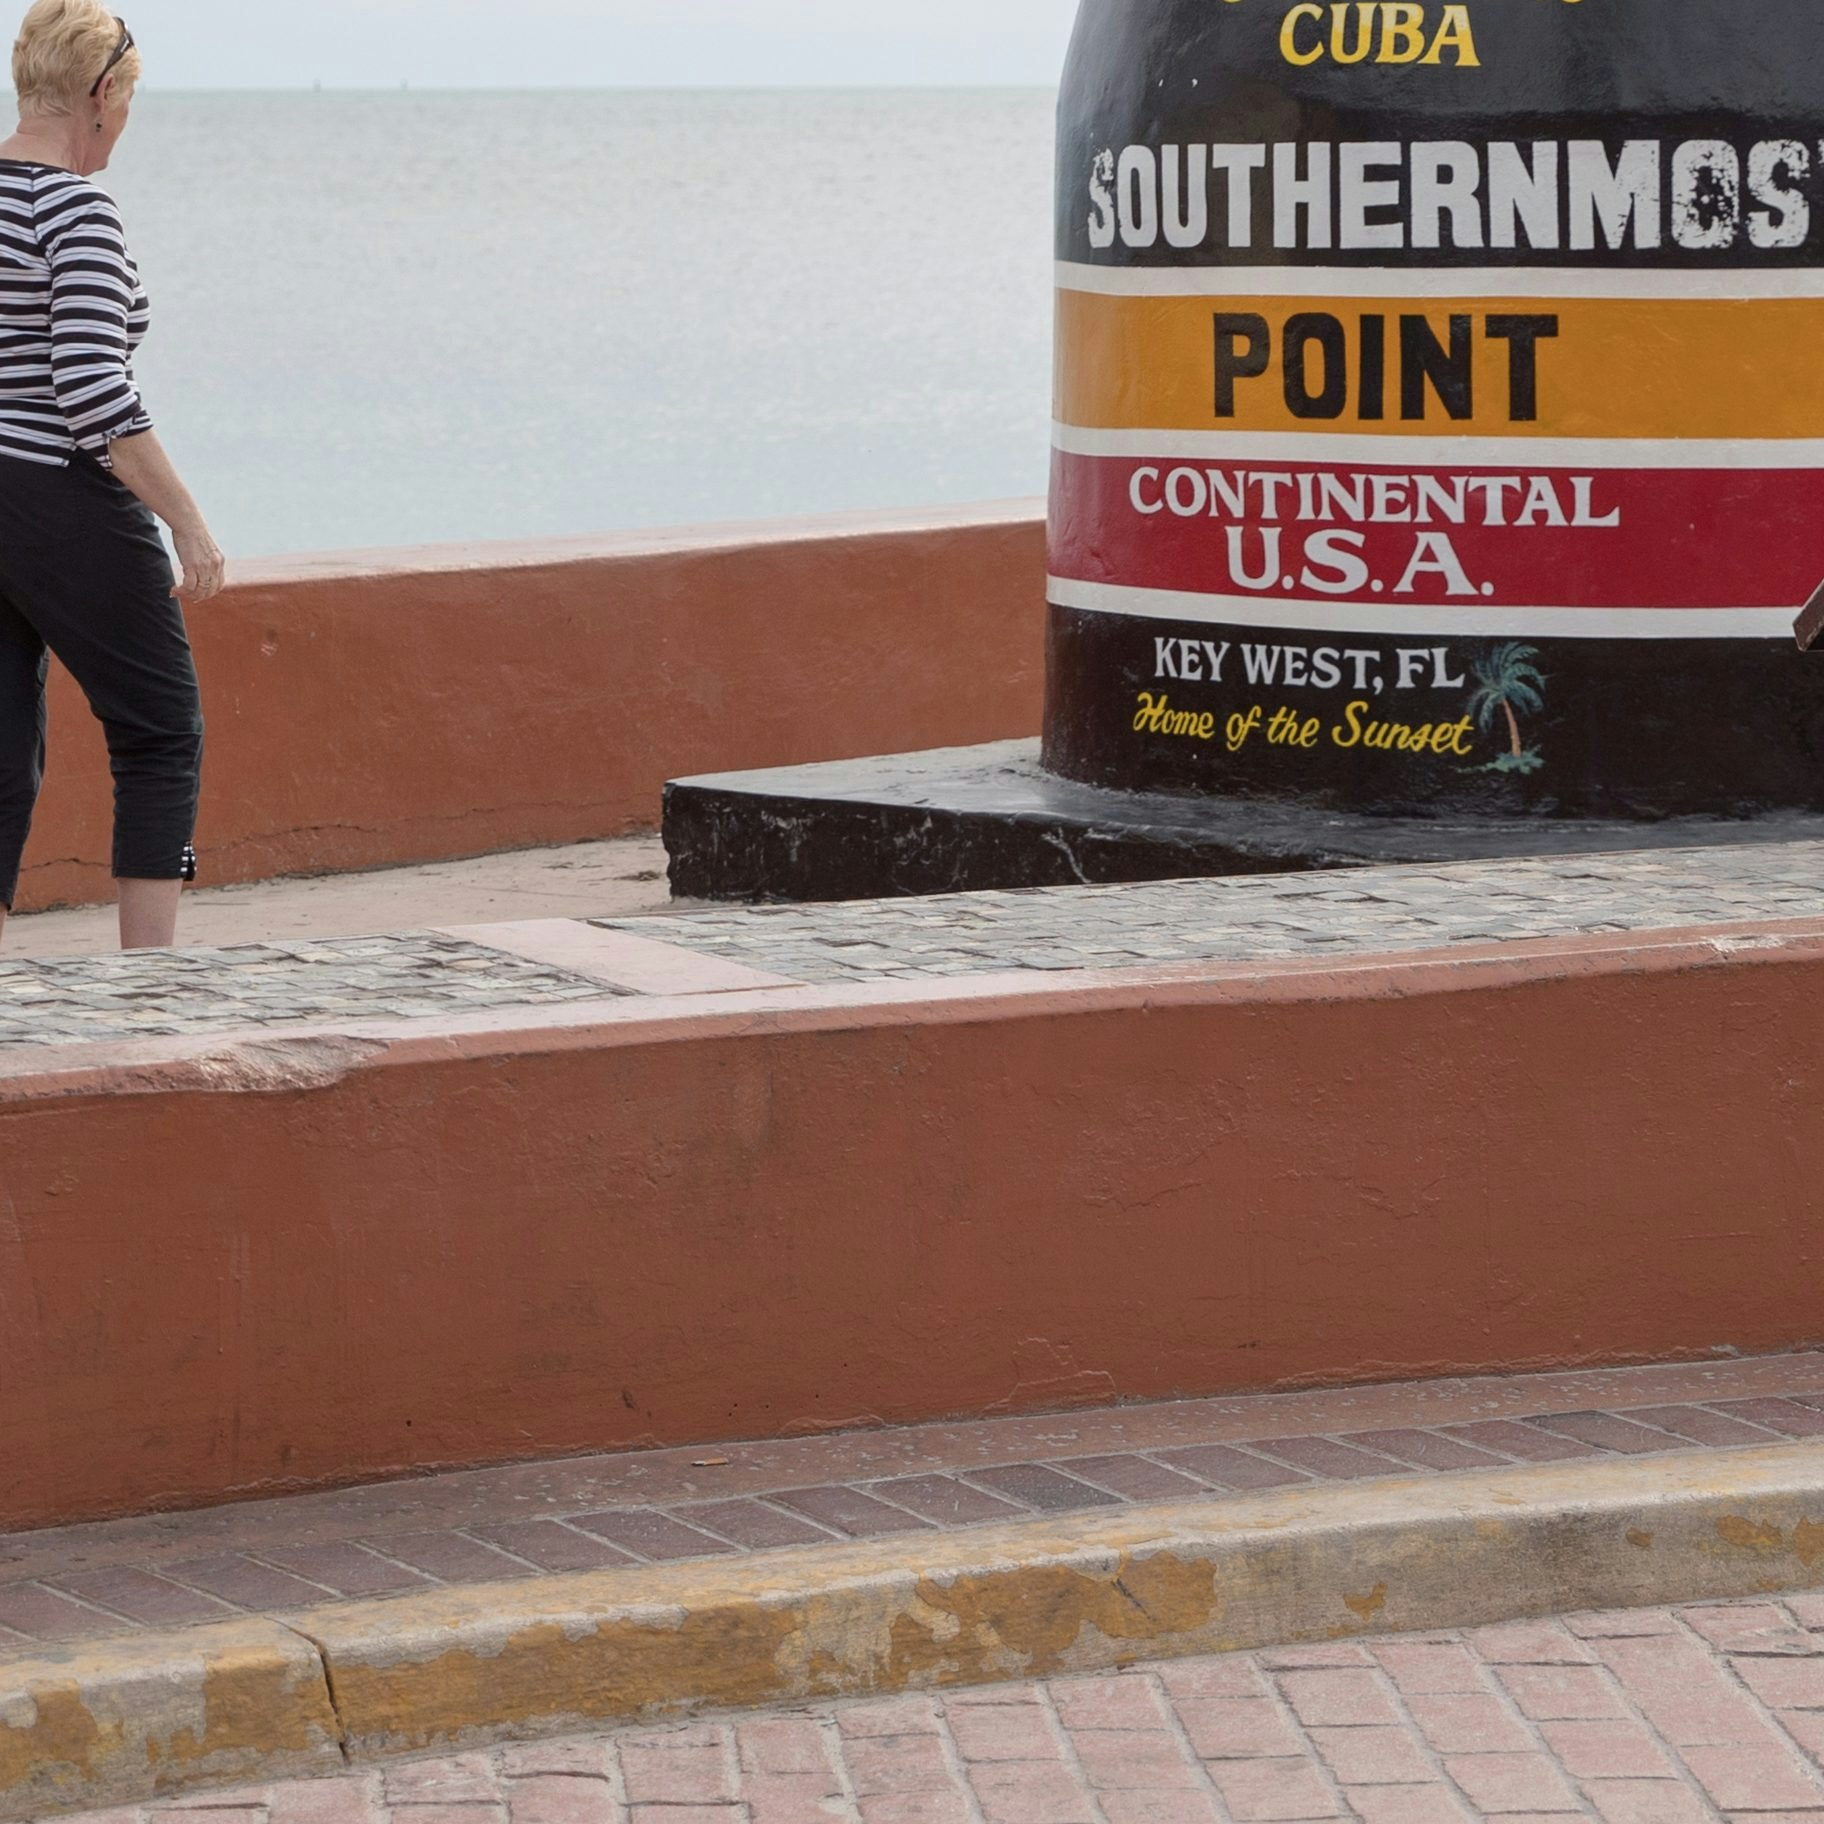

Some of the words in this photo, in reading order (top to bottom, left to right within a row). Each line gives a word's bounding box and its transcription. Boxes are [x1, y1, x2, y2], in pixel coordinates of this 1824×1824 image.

[1279, 3, 1480, 67] CUBA
[1213, 312, 1559, 422] POINT
[1129, 467, 1620, 527] CONTINENTAL
[1225, 527, 1495, 596] U.S.A.
[1153, 637, 1232, 682] KEY
[1242, 645, 1384, 695] WEST,
[1394, 647, 1465, 690] FL
[1132, 693, 1215, 739] Home
[1225, 706, 1262, 751] of
[1266, 707, 1319, 748] the
[1331, 701, 1475, 757] Sunset
